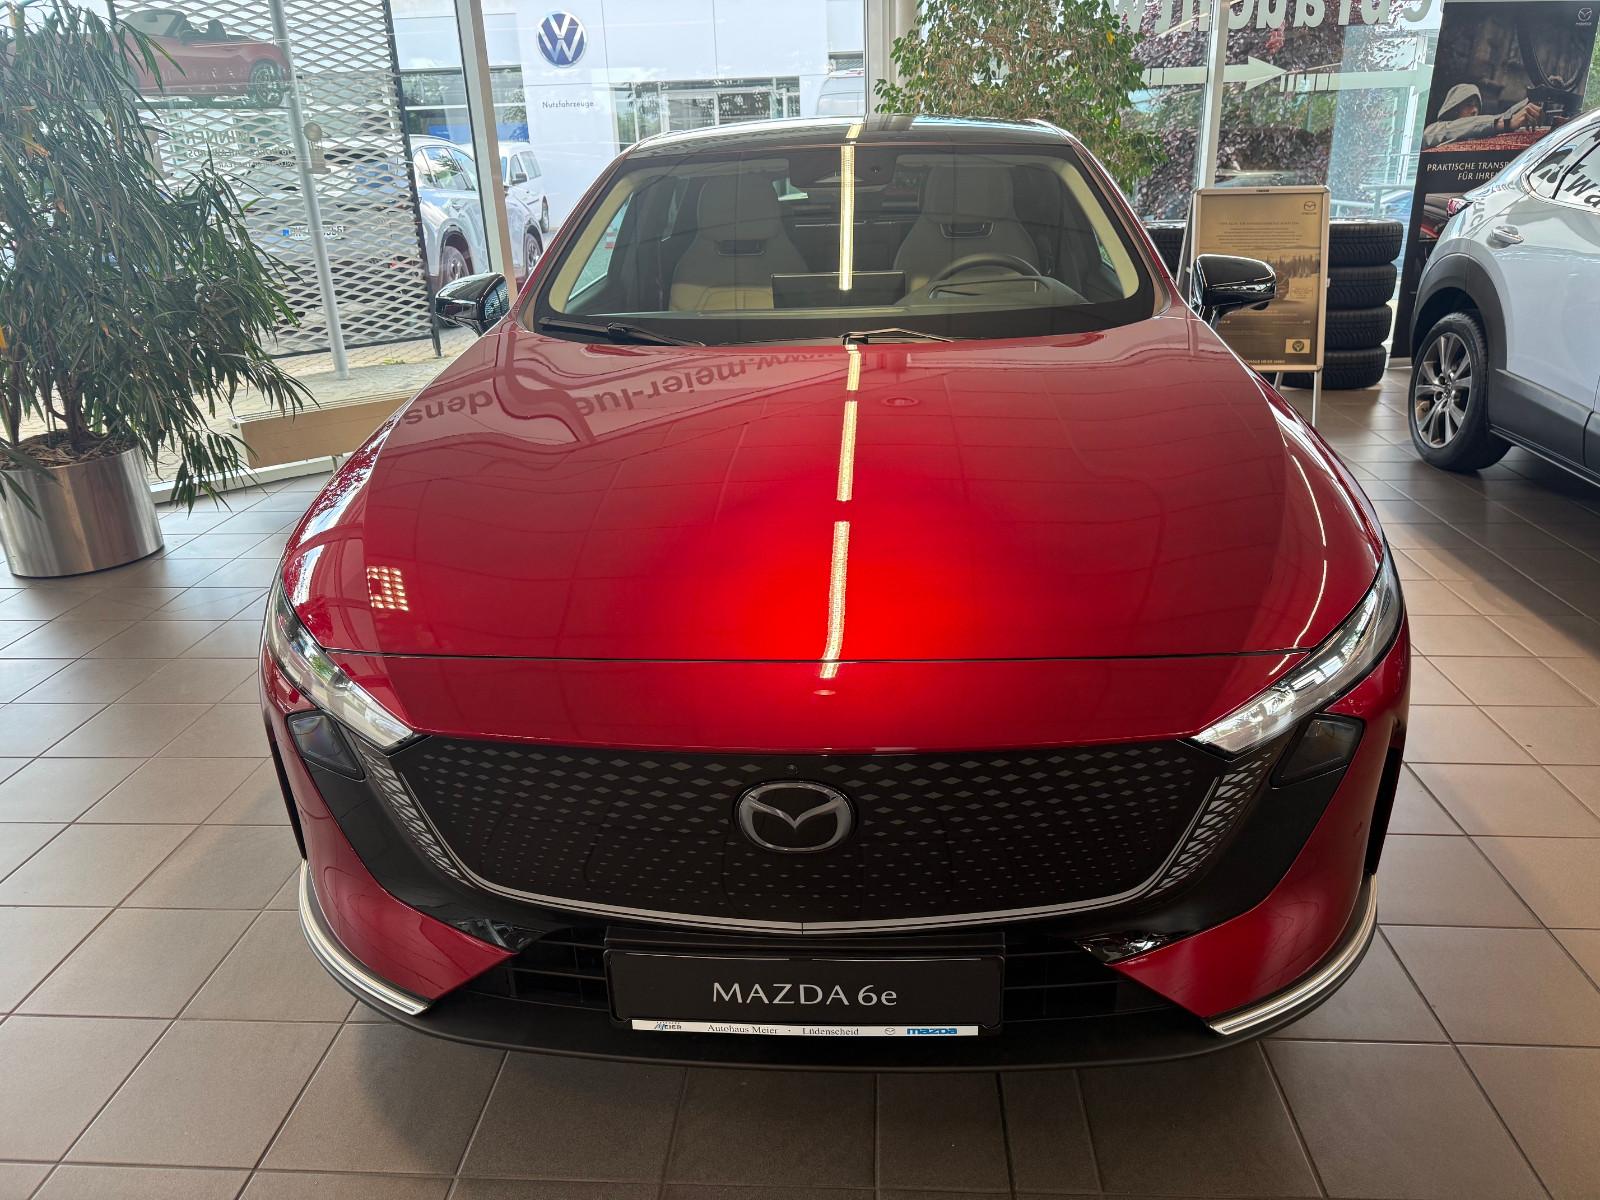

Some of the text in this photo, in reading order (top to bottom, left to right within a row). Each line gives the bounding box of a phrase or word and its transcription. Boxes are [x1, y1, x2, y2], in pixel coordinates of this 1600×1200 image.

[542, 99, 595, 109] Nutzfahrzeuge
[1427, 162, 1476, 172] PRAKTISCHE
[1457, 172, 1474, 181] FÜR
[713, 982, 897, 1006] MAZDA 6e
[707, 1024, 750, 1033] Autohaus
[751, 1025, 779, 1034] Meier
[802, 1027, 859, 1036] Lüdenscheid
